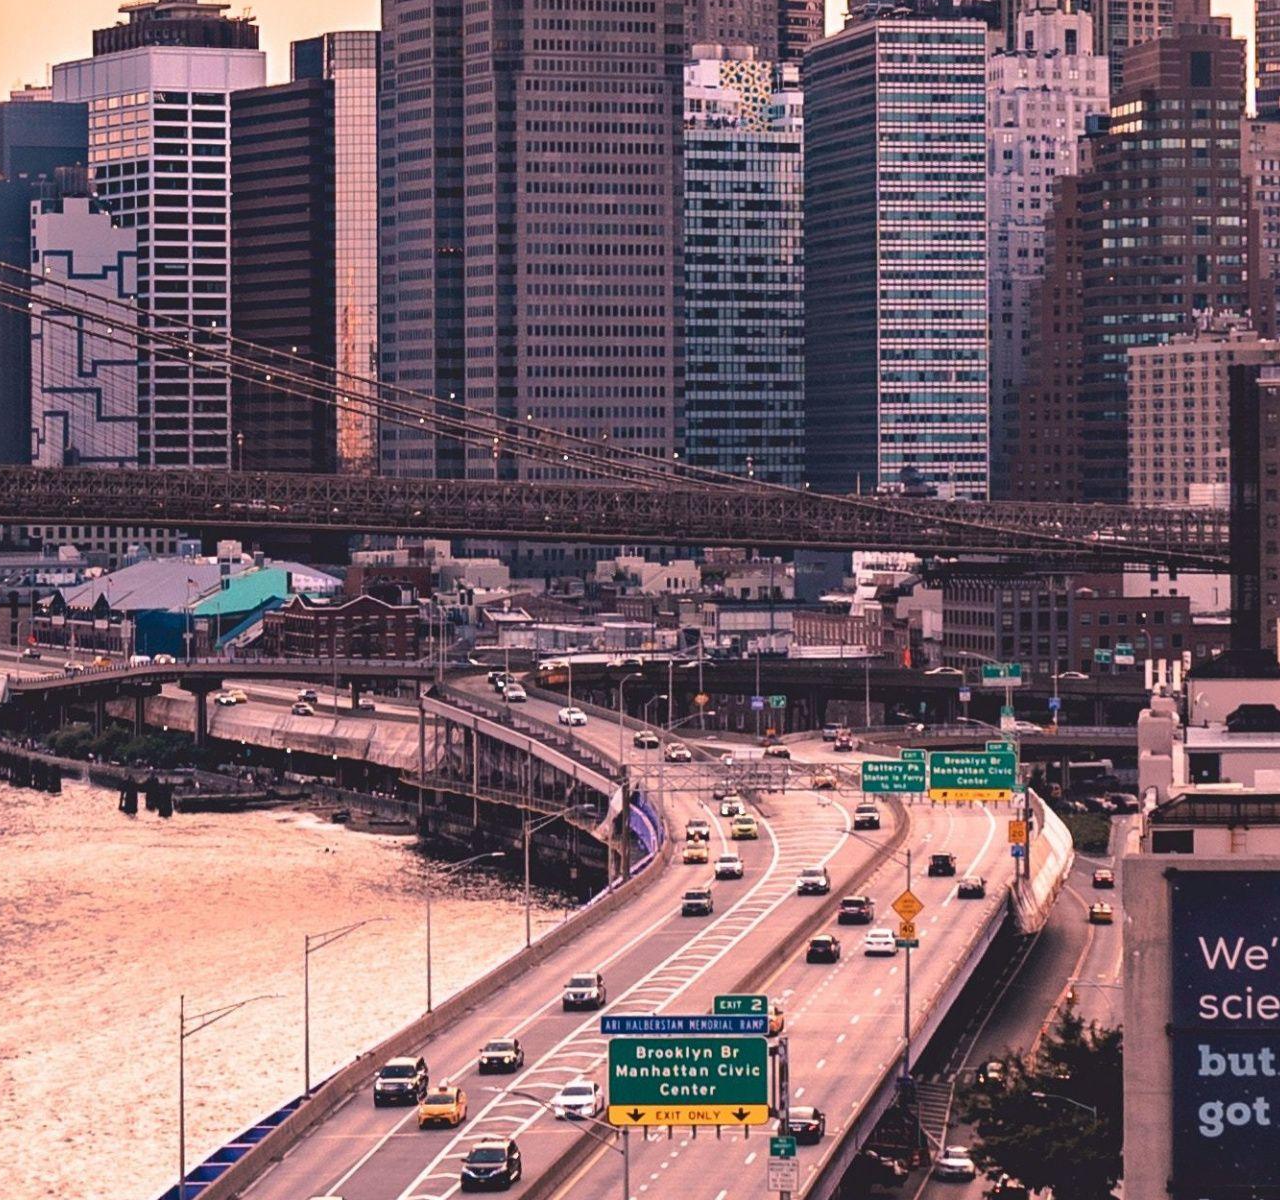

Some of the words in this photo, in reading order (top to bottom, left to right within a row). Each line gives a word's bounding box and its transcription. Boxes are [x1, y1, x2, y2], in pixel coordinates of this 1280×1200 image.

[944, 756, 987, 766] Brooklyn
[990, 756, 1002, 765] Br
[867, 763, 903, 773] Battery
[933, 767, 985, 775] Manhattan
[988, 767, 1012, 775] Civic
[902, 774, 924, 782] Ferry
[956, 777, 989, 785] Center
[902, 925, 914, 933] 40
[720, 1001, 742, 1009] EXIT
[751, 1000, 762, 1011] 2
[626, 1020, 684, 1030] HALBERSTAM
[689, 1020, 734, 1030] MEMORIAL
[740, 1020, 764, 1030] RAMP
[636, 1046, 712, 1061] Brooklyn
[721, 1046, 739, 1059] Br
[1198, 1045, 1276, 1077] but
[616, 1065, 709, 1077] Manhattan
[717, 1064, 760, 1076] Civic
[660, 1083, 717, 1096] Center
[656, 1111, 681, 1120] EXIT
[688, 1111, 721, 1120] ONLY
[1198, 1097, 1270, 1137] got
